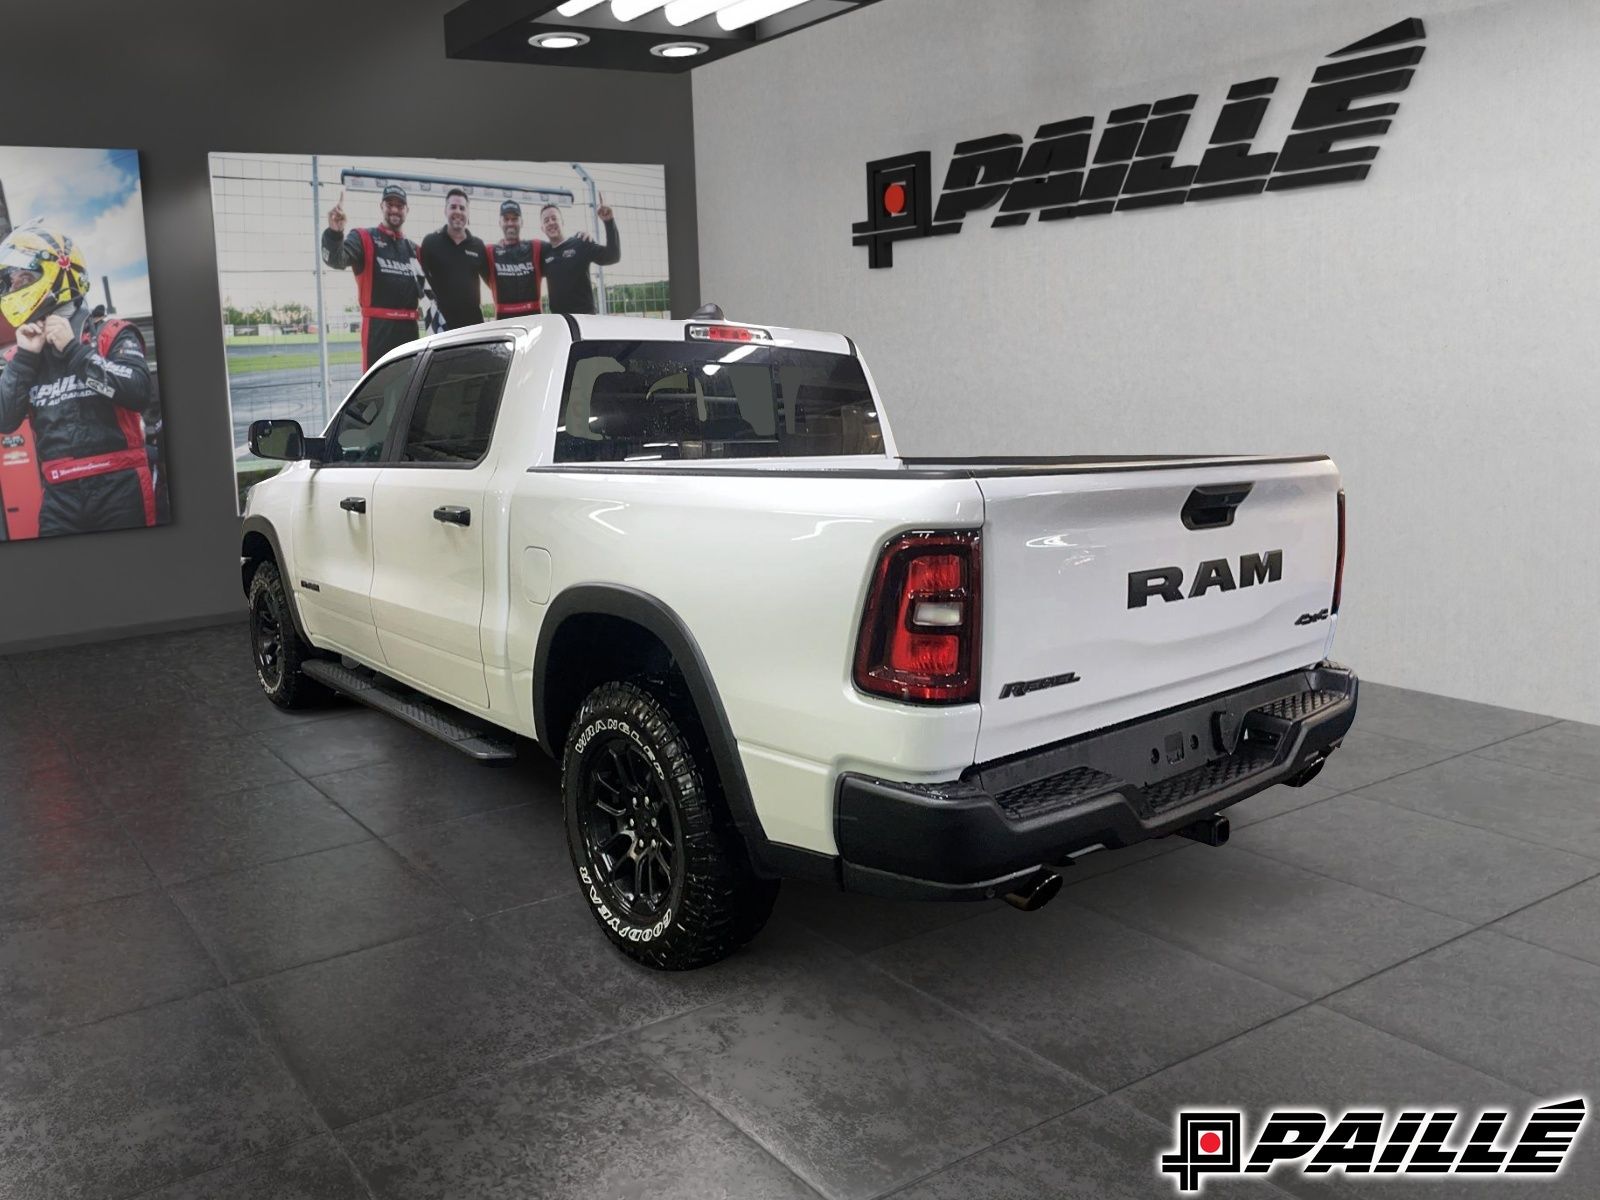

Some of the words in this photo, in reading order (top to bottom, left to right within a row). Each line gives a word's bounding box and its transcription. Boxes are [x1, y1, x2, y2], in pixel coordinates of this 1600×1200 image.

[932, 17, 1426, 236] PAILLÉ
[1127, 549, 1283, 609] RAM
[998, 672, 1081, 699] REBEL
[575, 718, 665, 781] WRANGLER
[579, 866, 672, 941] GOODYEAR
